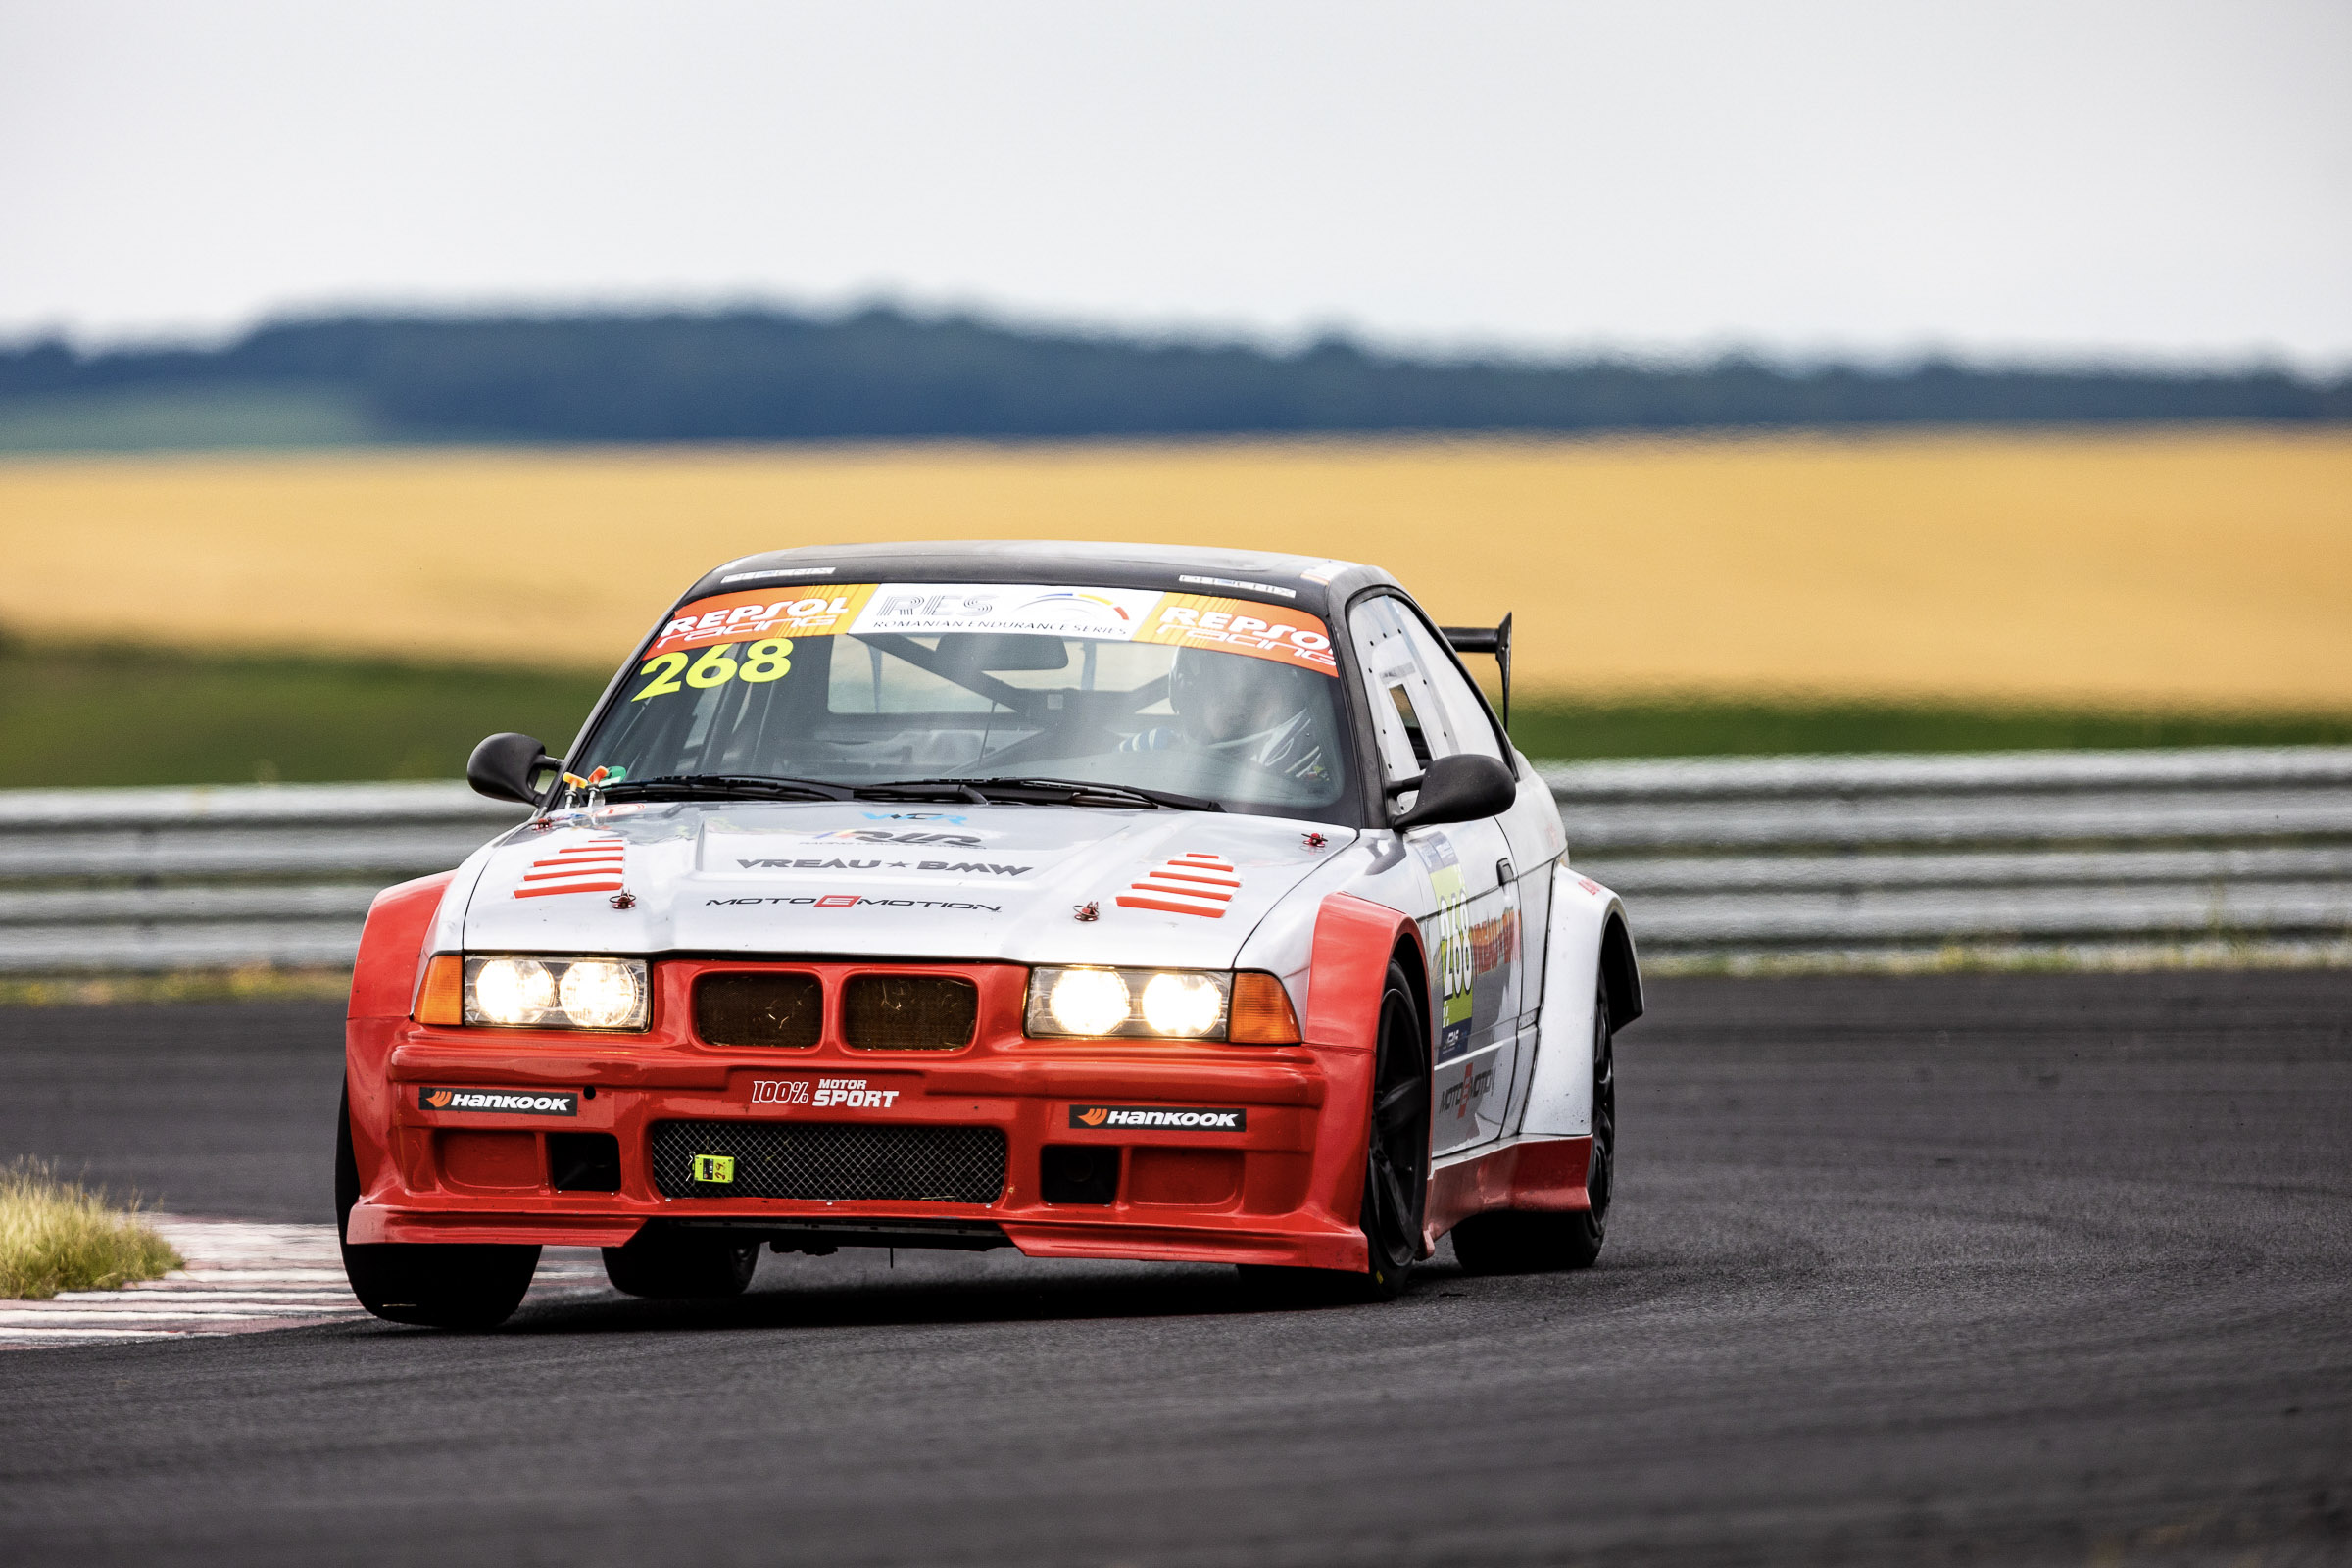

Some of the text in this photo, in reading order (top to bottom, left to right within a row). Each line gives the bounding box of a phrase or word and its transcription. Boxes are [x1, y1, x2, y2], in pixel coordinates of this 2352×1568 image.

[660, 597, 849, 638] REPSOL
[876, 594, 995, 616] RES
[873, 620, 1128, 635] ROMANIAN ENDURANCE SERIES
[1159, 606, 1334, 654] REPSO
[630, 638, 794, 703] 268
[737, 858, 1034, 876] VREAU BMW
[1440, 889, 1473, 1001] 268
[752, 1081, 899, 1108] 100% SPORT
[818, 1079, 867, 1090] MOTOR
